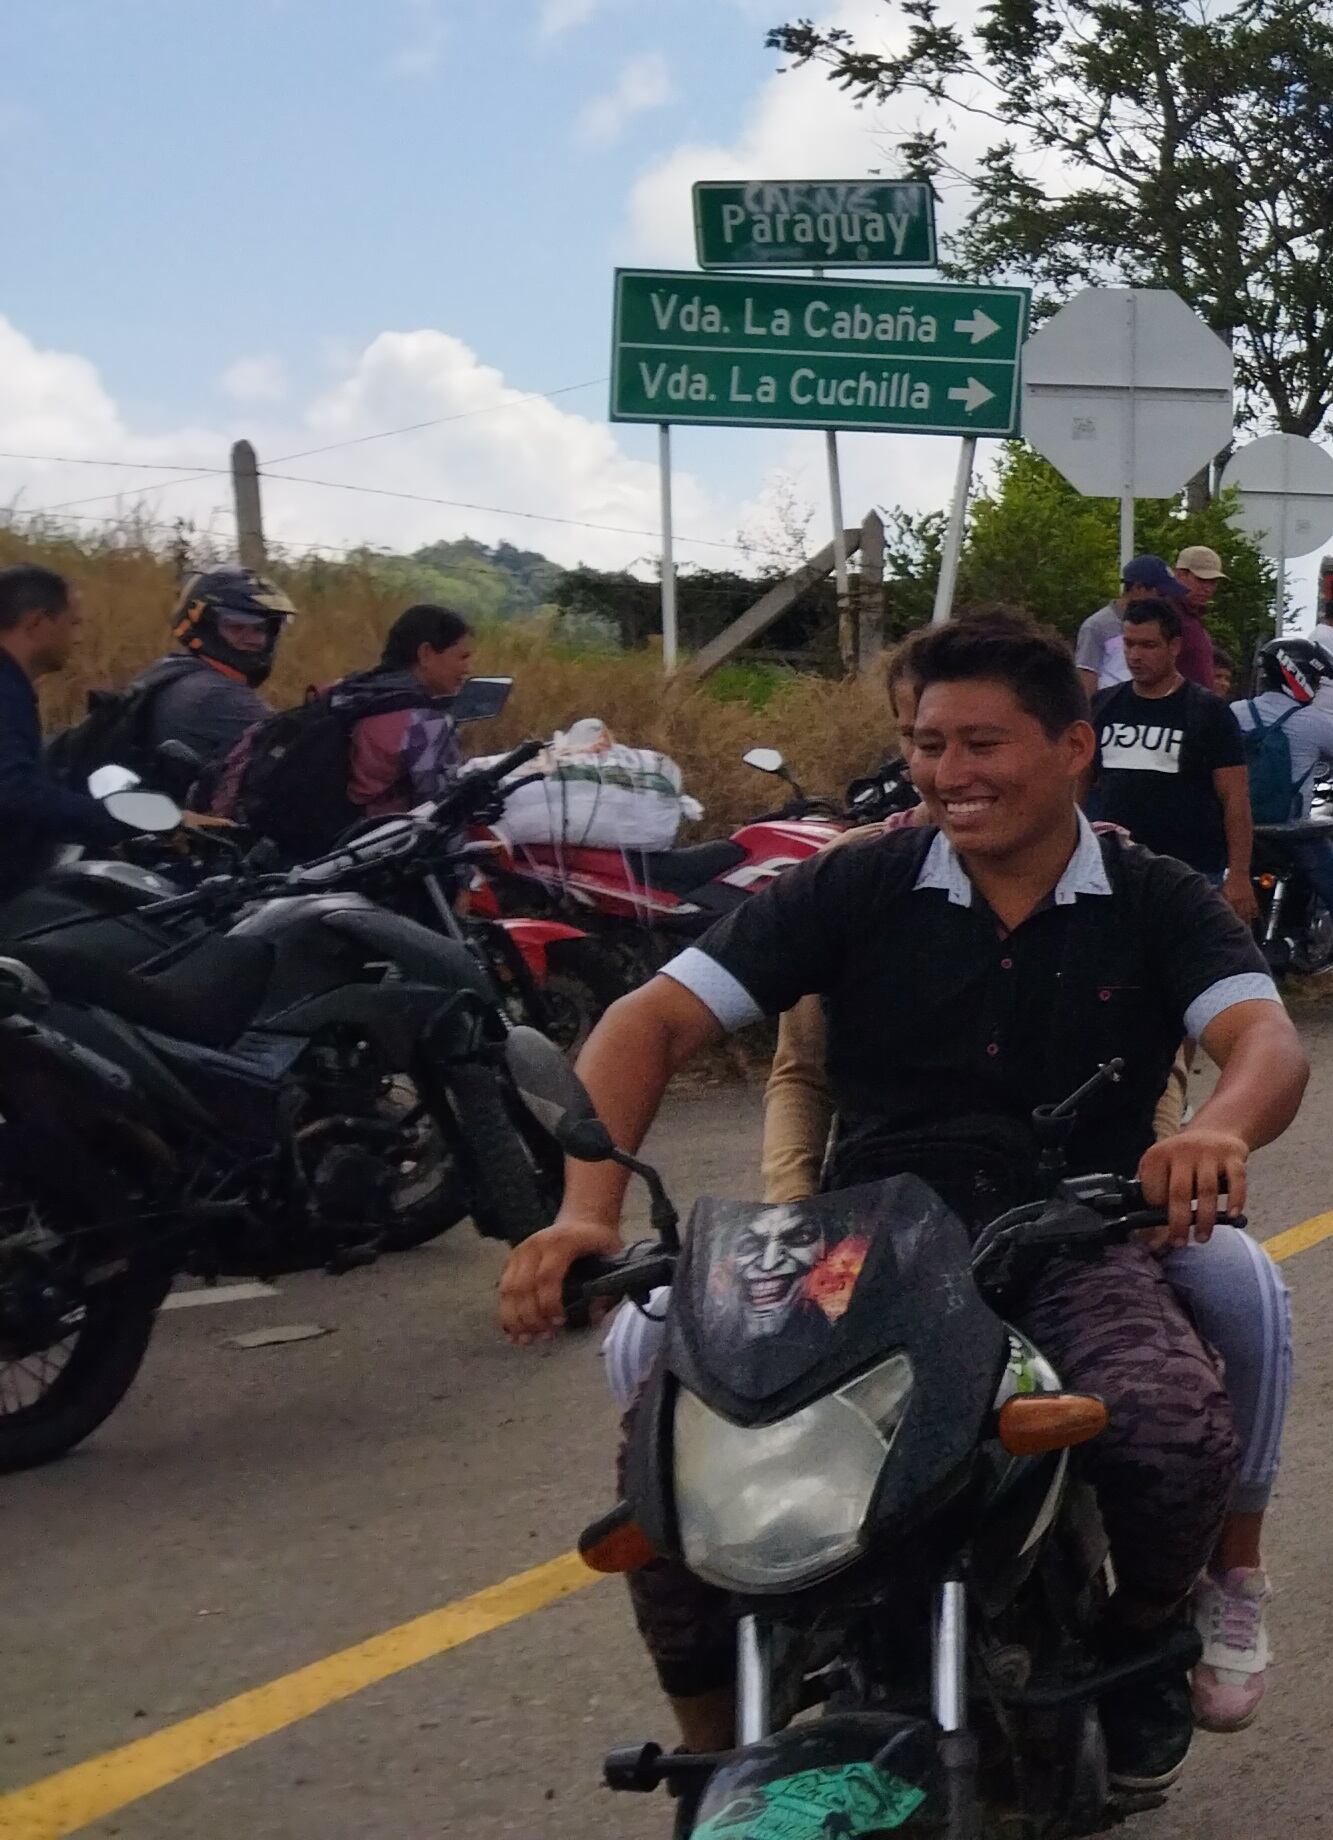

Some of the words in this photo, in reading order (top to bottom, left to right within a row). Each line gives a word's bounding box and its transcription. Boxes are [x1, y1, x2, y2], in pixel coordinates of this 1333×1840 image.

[721, 204, 909, 256] Paraguay
[651, 293, 730, 334] Vda.
[743, 298, 790, 337] La
[804, 302, 936, 343] Cabaña
[639, 362, 717, 402] Vda.
[730, 366, 776, 403] La
[790, 368, 930, 409] Cuchilla
